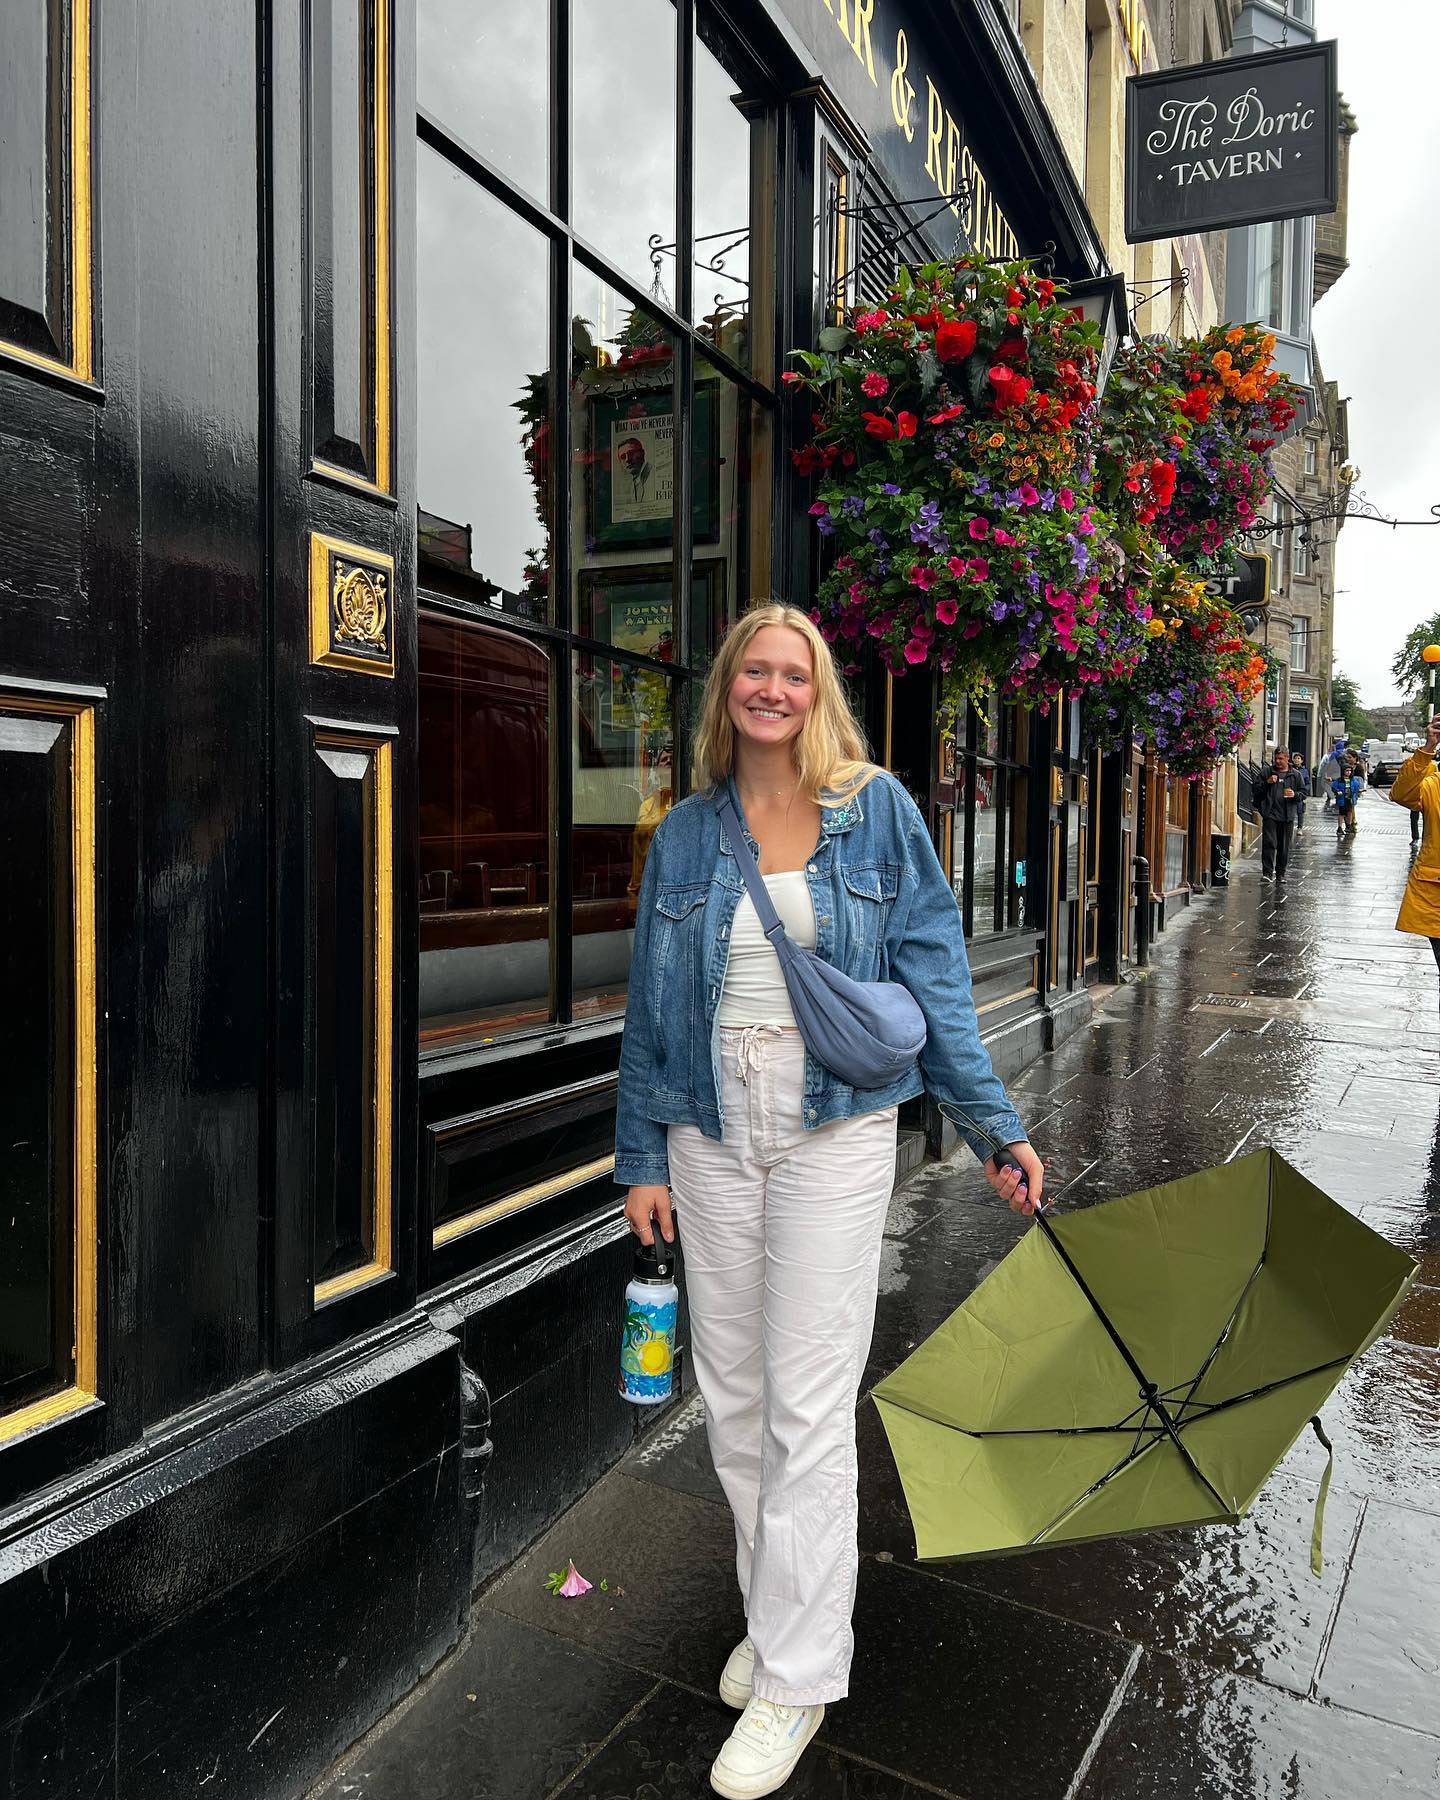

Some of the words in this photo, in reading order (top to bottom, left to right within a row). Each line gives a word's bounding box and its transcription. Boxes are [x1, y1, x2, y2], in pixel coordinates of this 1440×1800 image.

[891, 29, 916, 143] &
[1147, 95, 1218, 155] The
[1221, 87, 1315, 145] Doric
[1170, 148, 1283, 186] TAVERN
[615, 420, 628, 433] WHAT
[649, 416, 666, 428] NEVER
